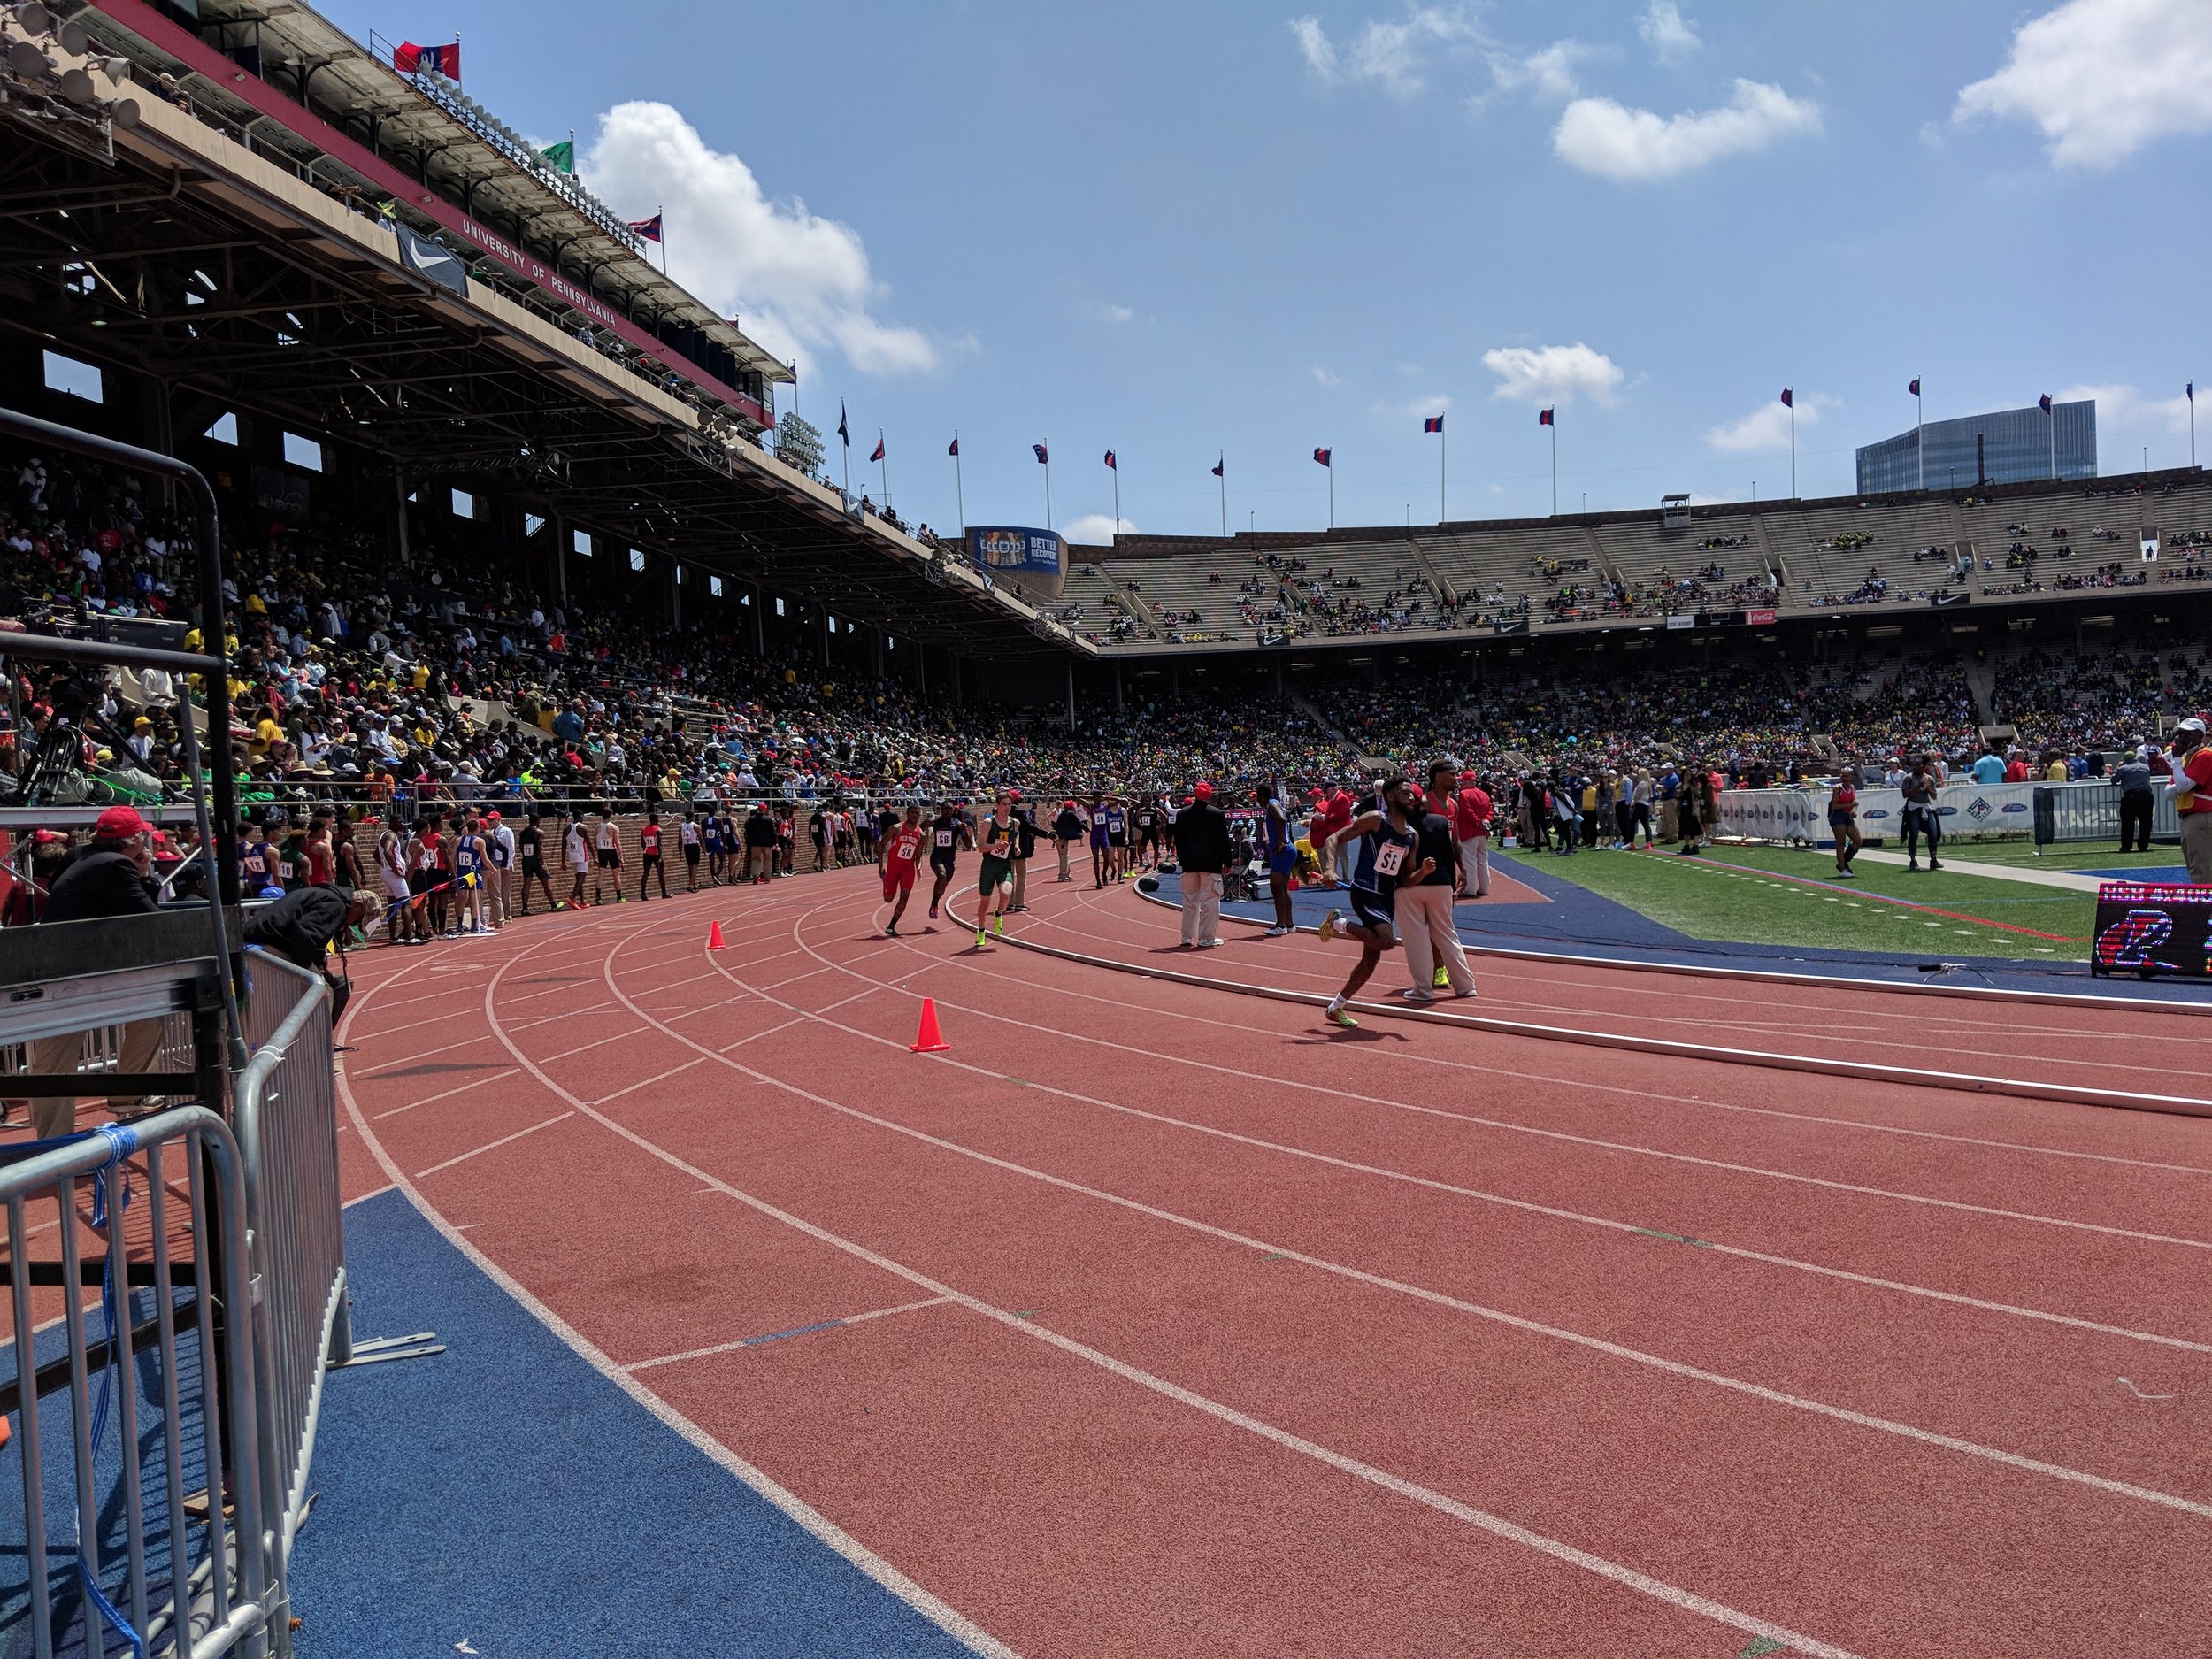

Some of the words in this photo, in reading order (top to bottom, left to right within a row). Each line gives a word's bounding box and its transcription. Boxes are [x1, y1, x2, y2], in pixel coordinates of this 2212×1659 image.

[463, 219, 525, 268] UNIVERSITY
[532, 265, 545, 280] OF
[551, 276, 616, 326] PENNSYLVANIA
[1031, 537, 1057, 551] BETTER
[1031, 549, 1057, 560] RECOVERY
[939, 835, 949, 844] SB
[902, 848, 912, 857] SK
[250, 861, 262, 871] TR
[1381, 852, 1398, 871] SE
